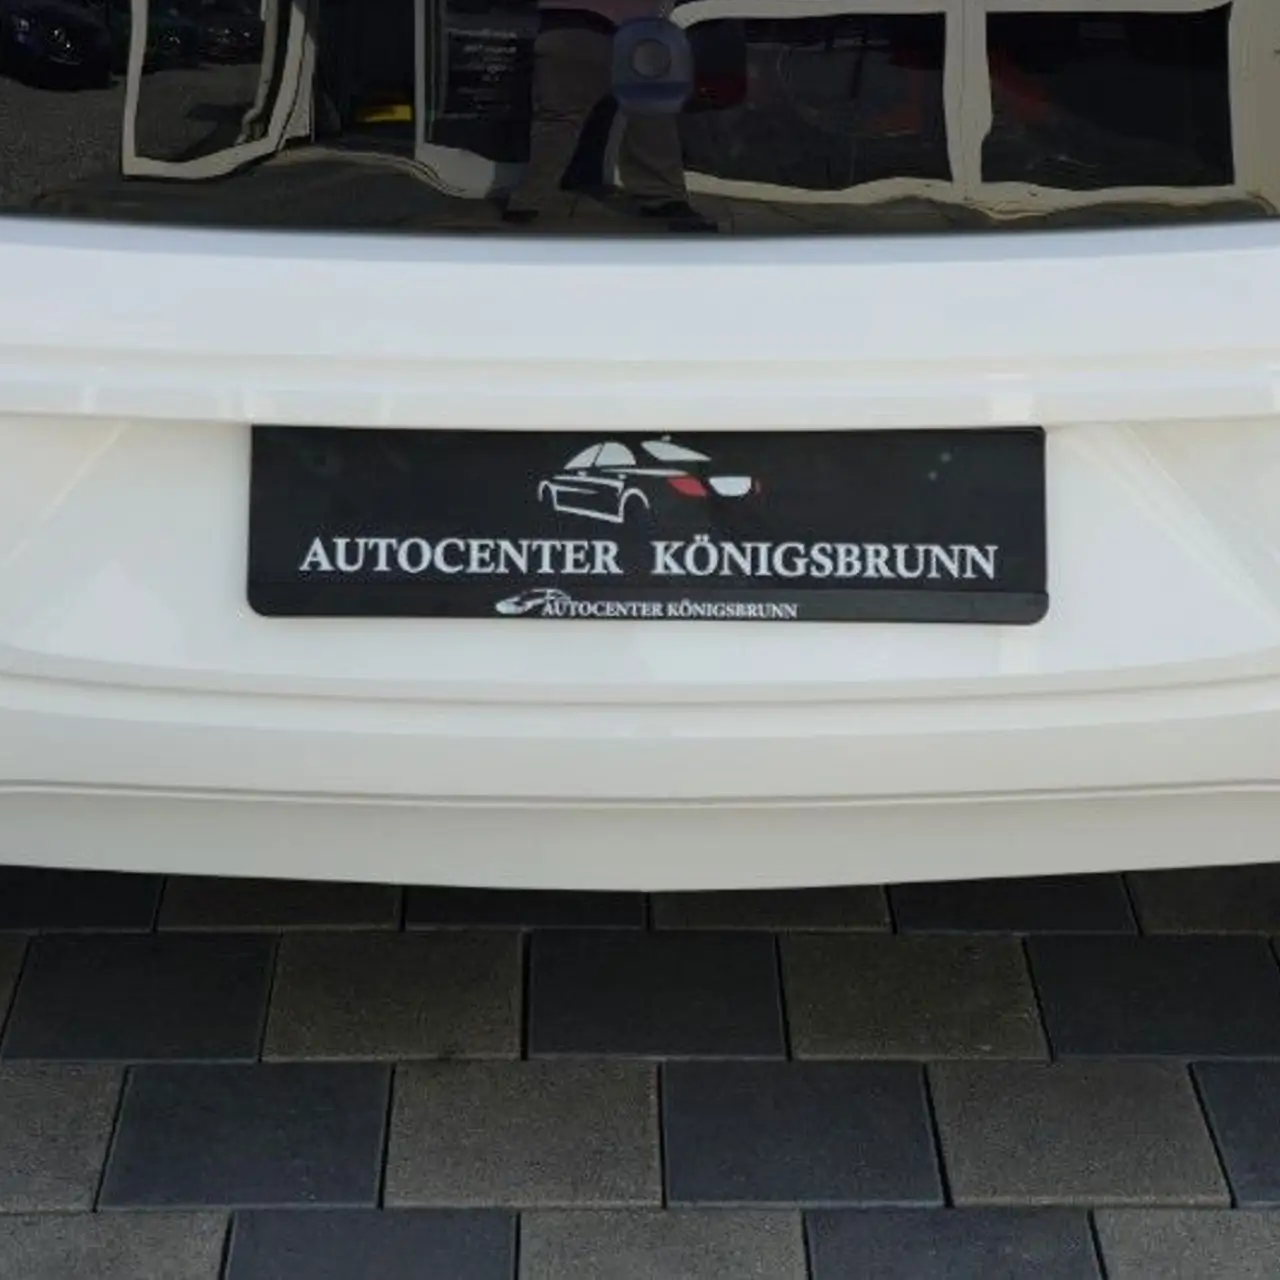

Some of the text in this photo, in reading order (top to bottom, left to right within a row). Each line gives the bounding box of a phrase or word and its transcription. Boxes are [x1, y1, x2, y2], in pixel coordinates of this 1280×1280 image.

[299, 534, 999, 580] AUTOCENTER KÖNIGSBRUNN
[542, 599, 798, 619] AUTOCENTER KÖNIGSBRUNN
